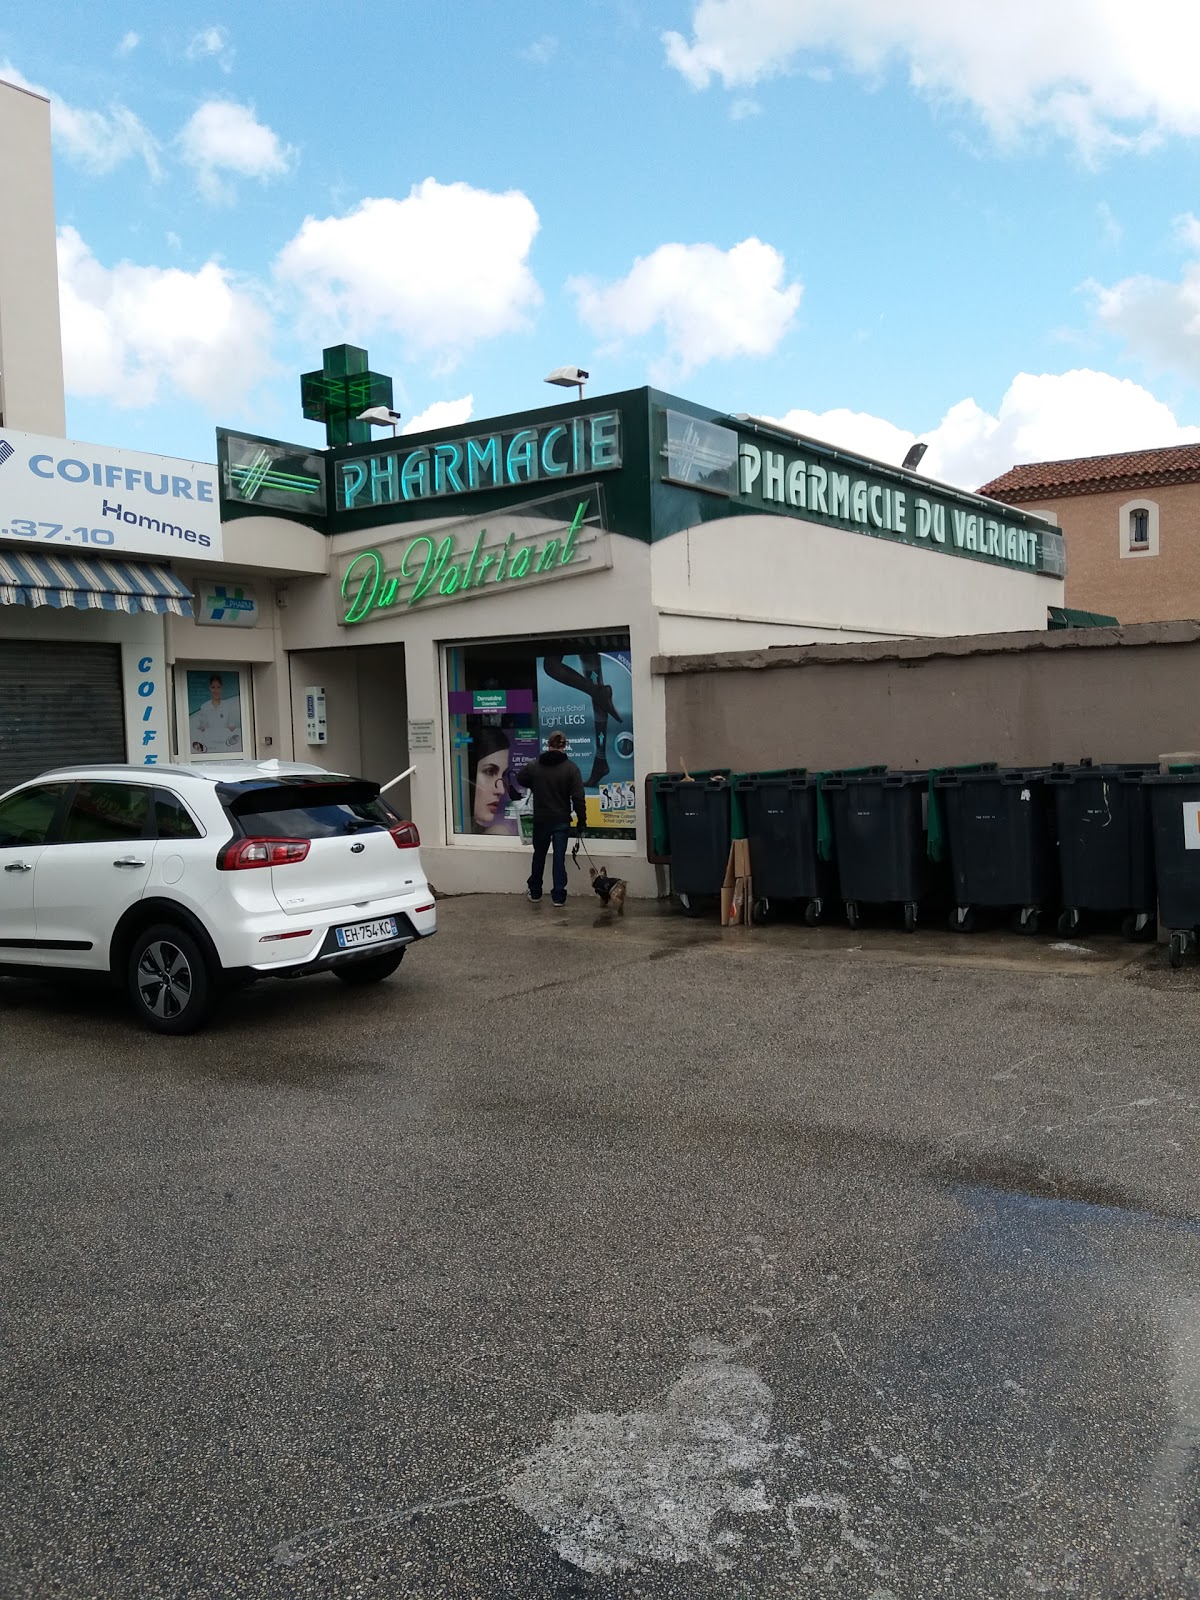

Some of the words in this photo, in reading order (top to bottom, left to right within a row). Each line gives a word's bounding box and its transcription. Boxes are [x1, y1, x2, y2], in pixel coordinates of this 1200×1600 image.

[28, 454, 214, 503] COIFFURE
[341, 412, 620, 508] PHARMACIE
[102, 499, 211, 548] Hommes
[738, 443, 907, 533] PHARMACIE
[915, 498, 946, 543] DU
[951, 508, 1038, 566] VALRIANT
[341, 548, 400, 622] Du
[401, 498, 591, 607] Valriant
[540, 705, 565, 713] Collants
[566, 704, 586, 712] Scholl
[541, 715, 562, 728] Light
[564, 714, 586, 725] LEGS
[344, 922, 392, 943] EH-754-KC
